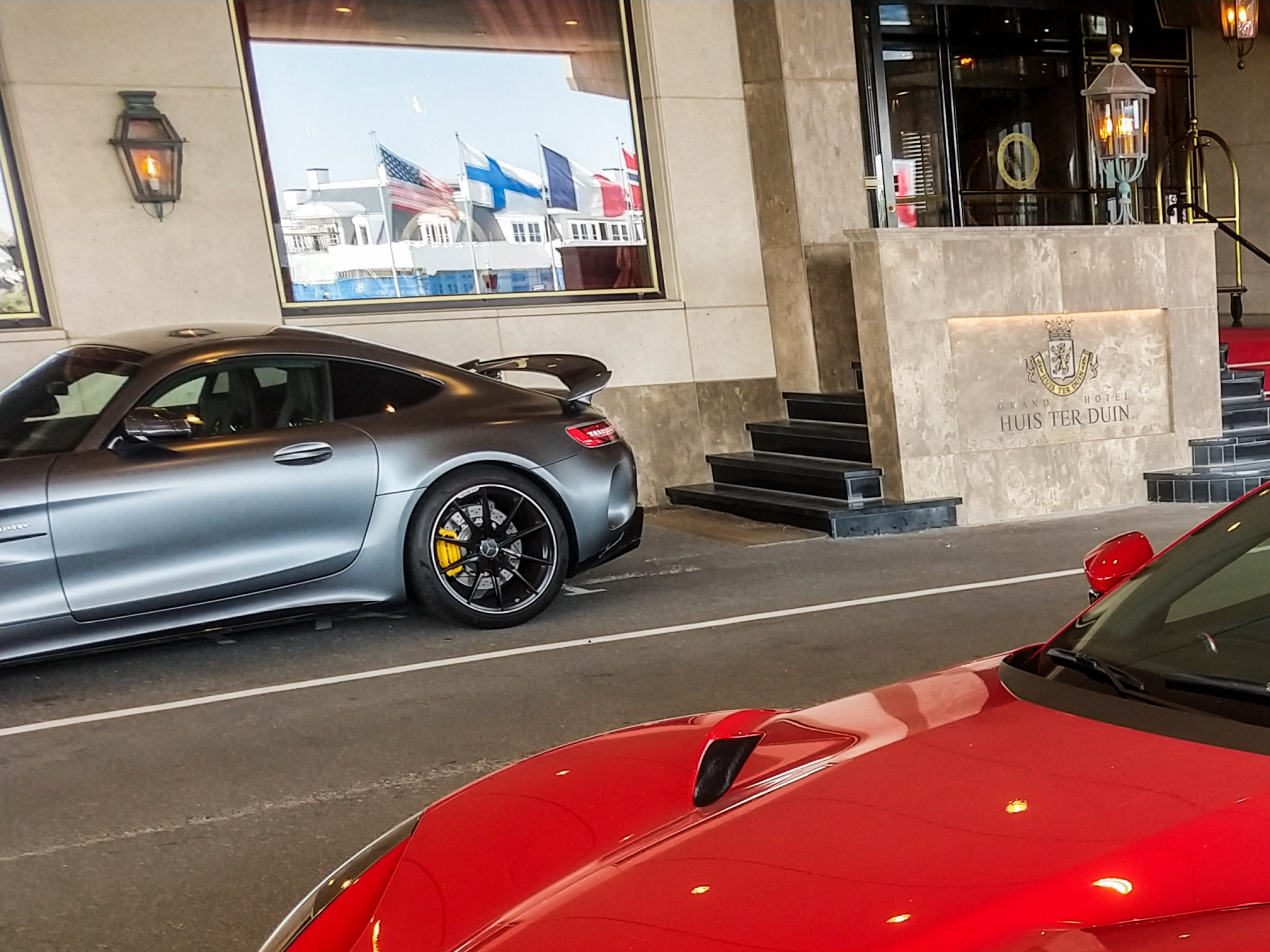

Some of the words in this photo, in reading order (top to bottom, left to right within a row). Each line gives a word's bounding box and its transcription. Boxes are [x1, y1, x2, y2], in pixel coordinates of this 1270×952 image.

[998, 399, 1050, 411] GRAND
[1084, 392, 1130, 404] HOTEL
[1000, 412, 1042, 432] HUIS
[1049, 409, 1081, 427] TER
[1088, 405, 1130, 424] DUIN
